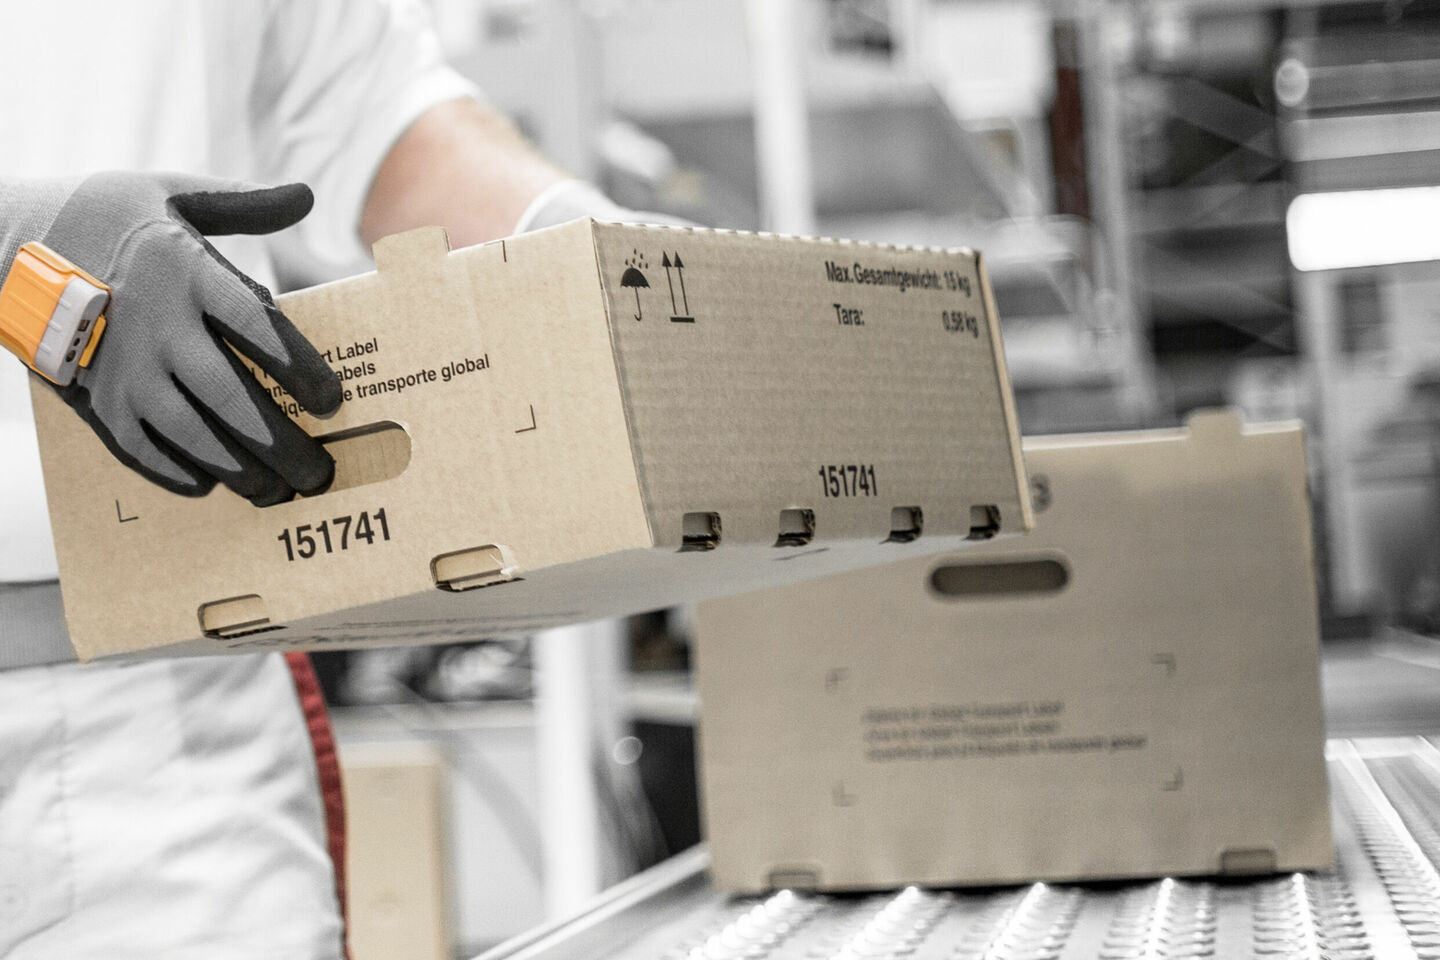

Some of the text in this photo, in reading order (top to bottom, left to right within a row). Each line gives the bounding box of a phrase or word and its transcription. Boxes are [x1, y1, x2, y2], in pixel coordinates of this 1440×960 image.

[825, 260, 972, 298] Max. Gesamtgewicht: 15 kg
[833, 303, 865, 326] Tara:
[965, 311, 979, 339] kg
[336, 337, 379, 361] Label
[336, 360, 376, 383] abels
[356, 366, 437, 399] transporte
[441, 353, 490, 383] global
[818, 464, 878, 498] 151741
[277, 507, 391, 562] 151741
